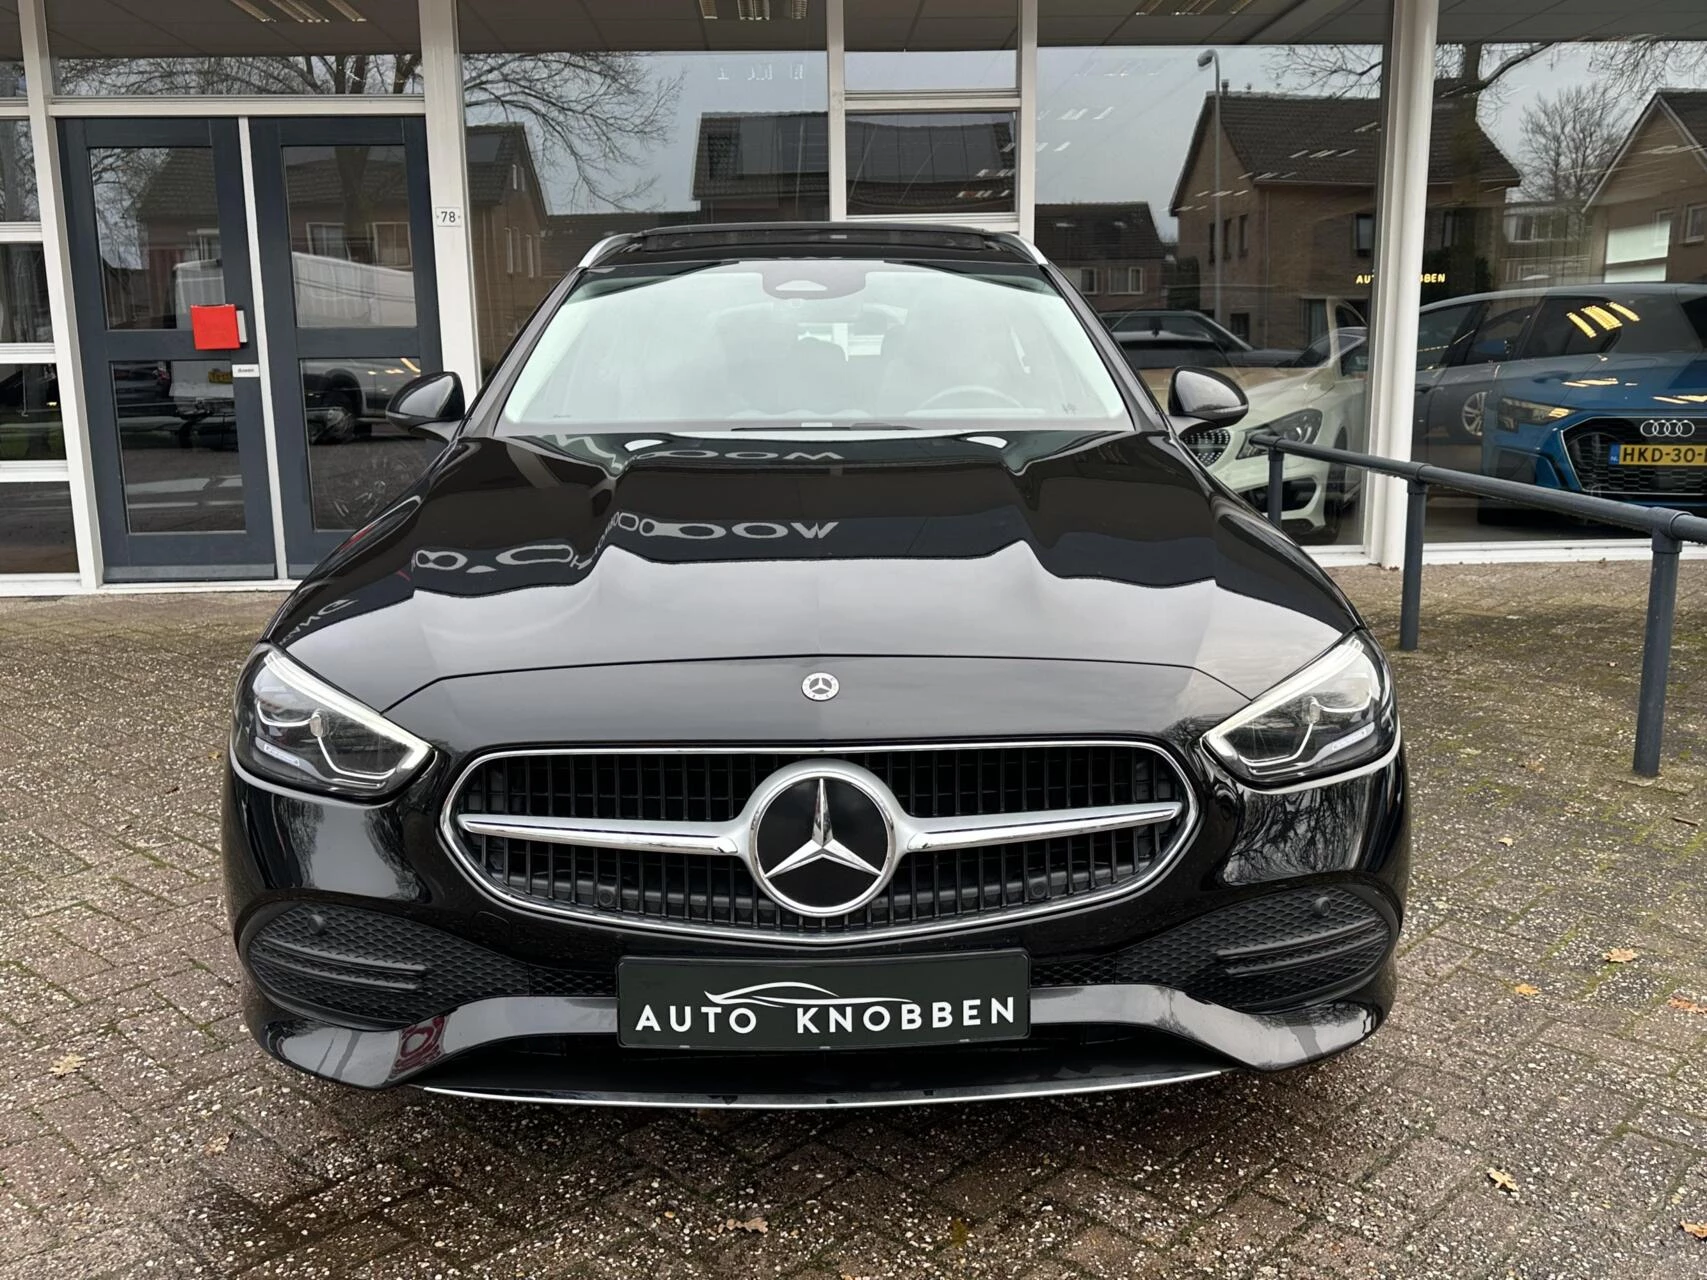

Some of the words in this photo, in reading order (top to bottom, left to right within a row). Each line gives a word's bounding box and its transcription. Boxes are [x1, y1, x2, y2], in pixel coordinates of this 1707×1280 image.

[441, 211, 456, 223] 78
[635, 1004, 757, 1034] AUTO
[796, 996, 1014, 1033] KNOBBEN
